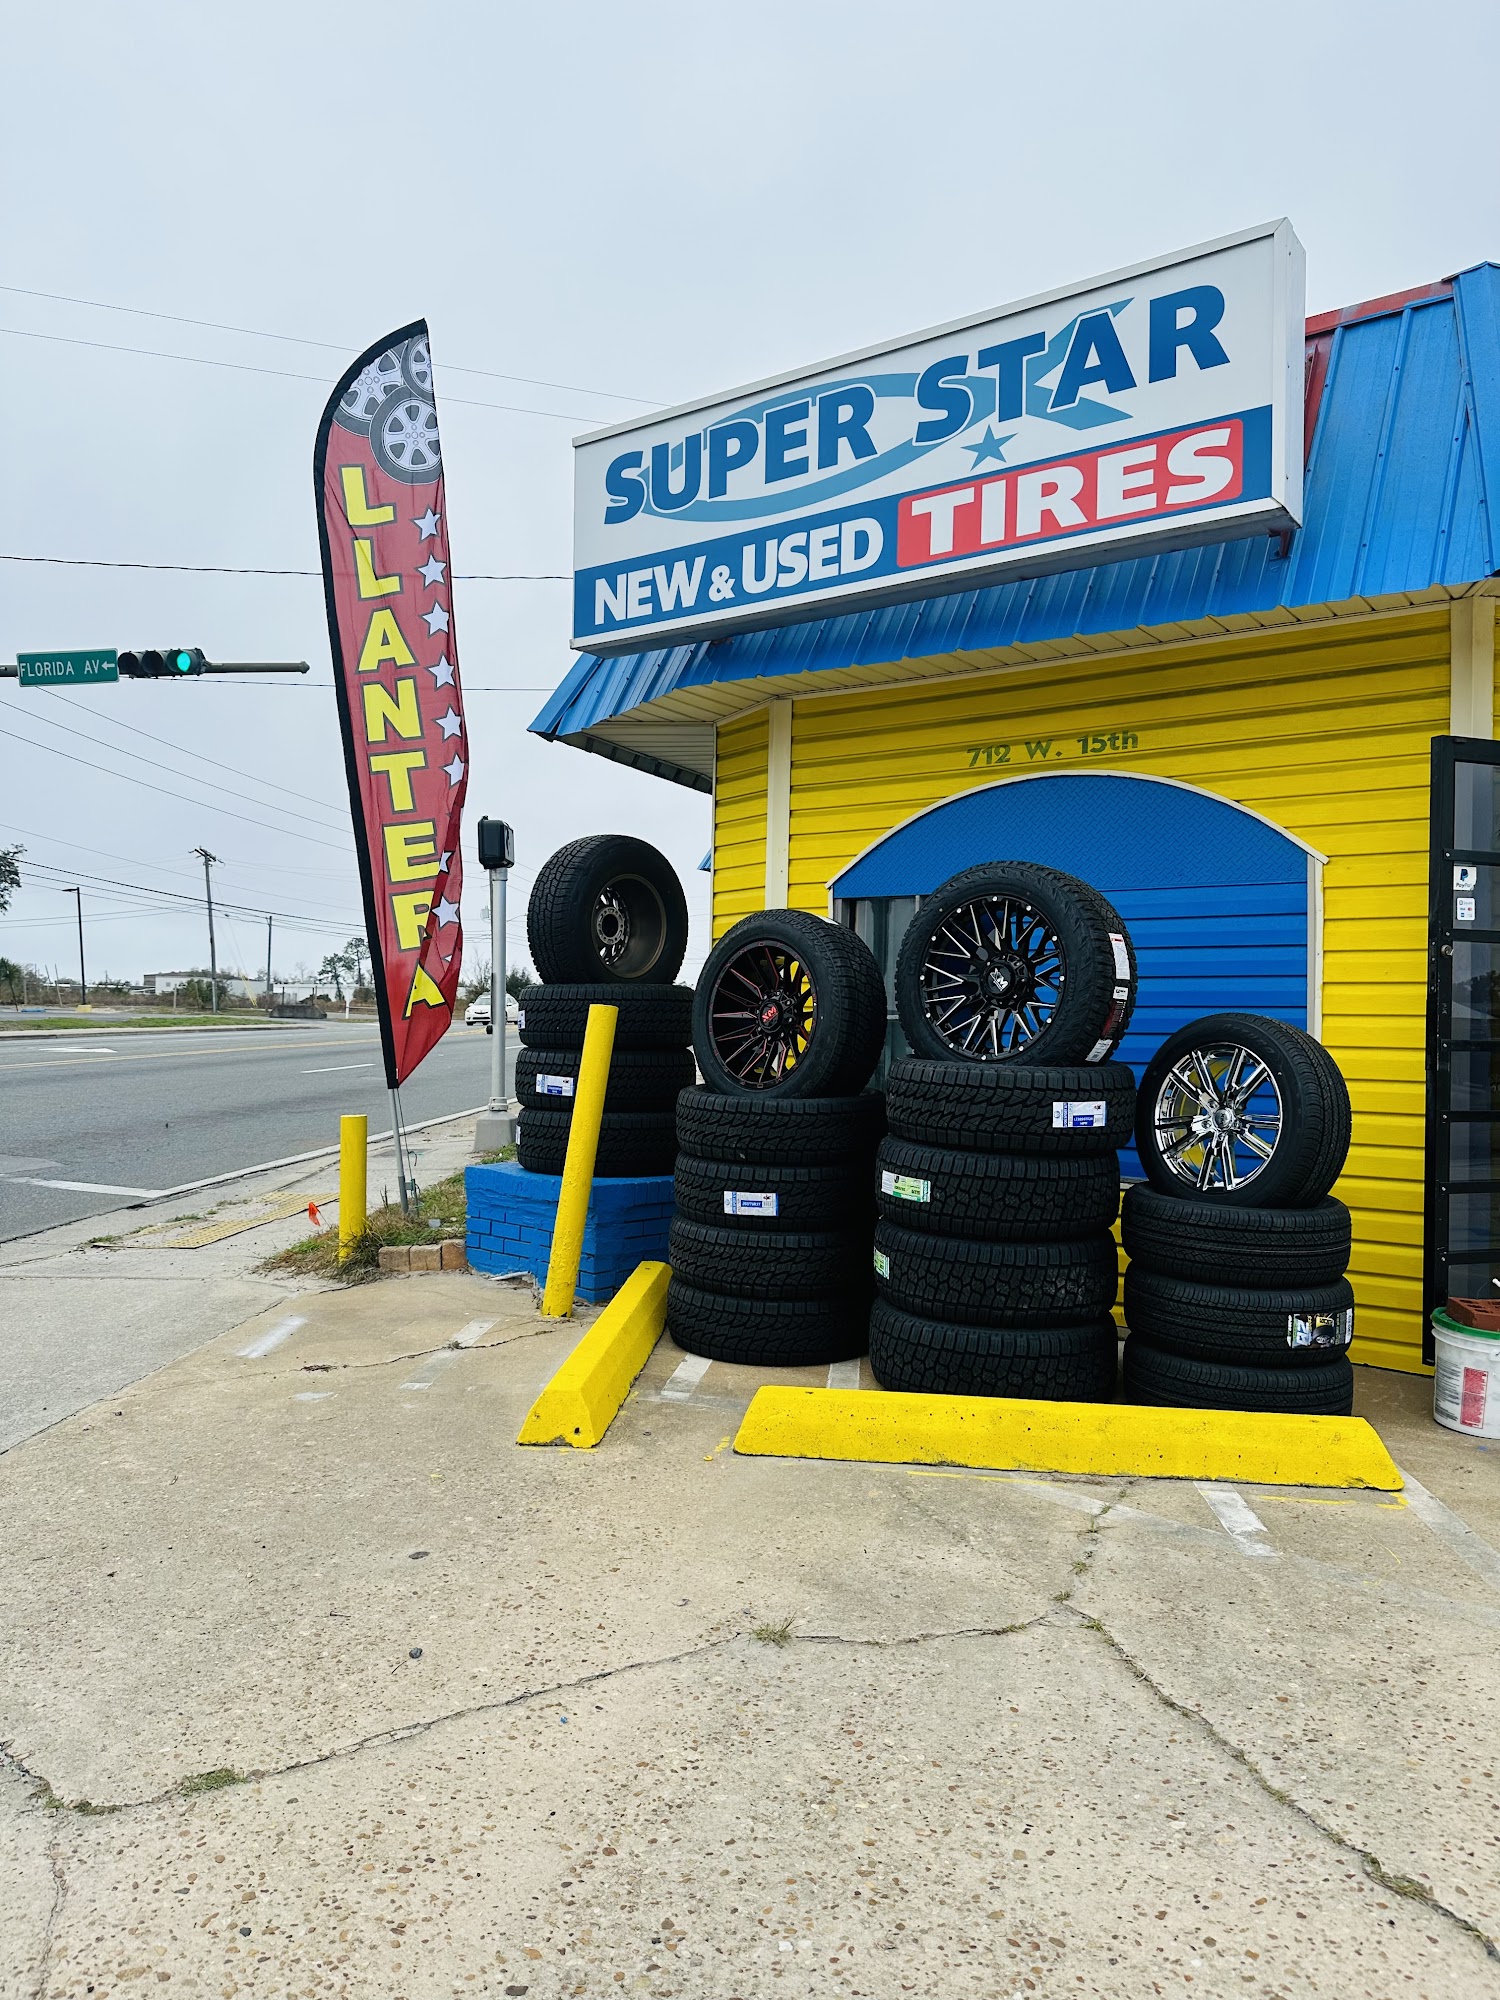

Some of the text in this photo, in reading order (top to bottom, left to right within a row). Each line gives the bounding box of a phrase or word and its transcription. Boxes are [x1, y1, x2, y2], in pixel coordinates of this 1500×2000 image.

[604, 284, 1232, 525] SUPER STAR
[594, 554, 706, 627] NEW
[740, 517, 885, 596] USED
[910, 427, 1237, 557] TIRES
[20, 658, 100, 678] FLORIDA AV
[966, 730, 1139, 768] 712 W. 15th
